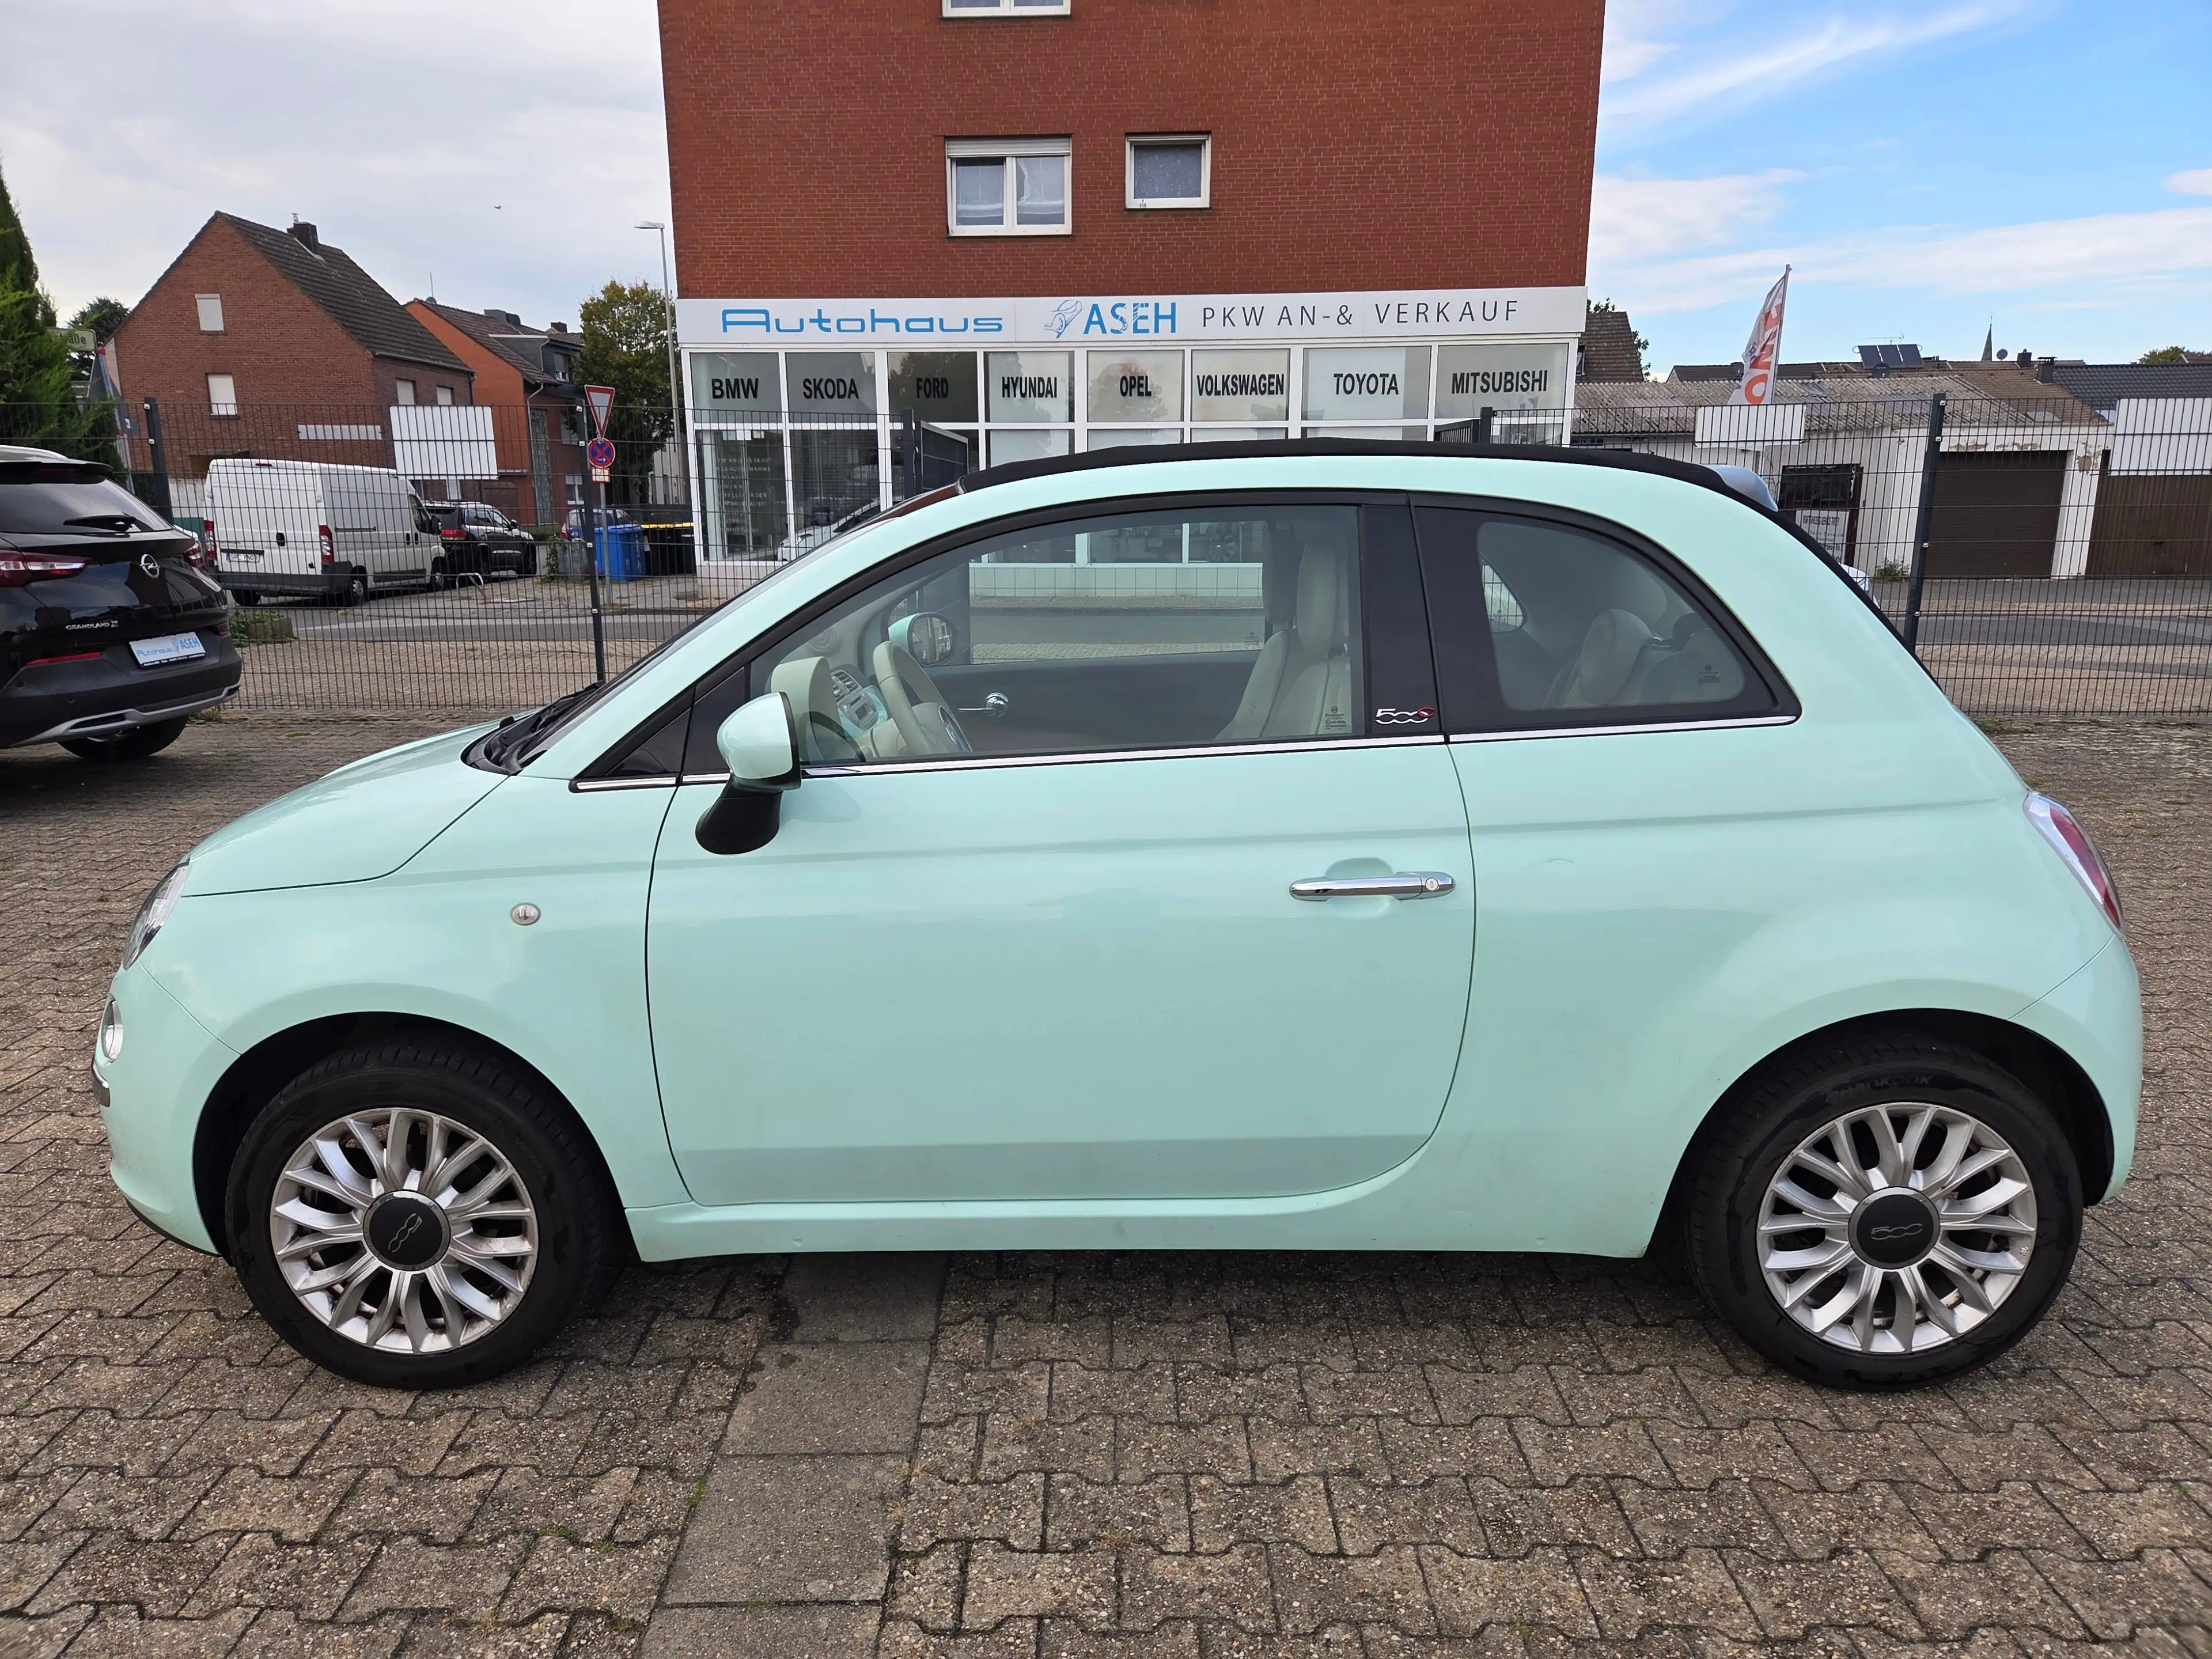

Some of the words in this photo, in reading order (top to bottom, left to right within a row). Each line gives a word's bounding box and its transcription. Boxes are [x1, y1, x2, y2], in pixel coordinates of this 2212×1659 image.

[721, 309, 1003, 333] Autohaus
[1083, 302, 1176, 334] ASEH
[1203, 306, 1264, 327] PKW
[1375, 300, 1517, 324] VERKAUF
[711, 377, 759, 399] BMW
[803, 378, 859, 399] SKODA
[916, 377, 949, 399] FORD
[1002, 376, 1057, 398] HYUNDAI
[1120, 376, 1152, 397] OPEL
[1197, 374, 1284, 396] VOLKSWAGEN
[1334, 373, 1399, 395] TOYOTA
[1452, 370, 1547, 394] MITSUBISHI
[65, 622, 110, 630] GRANDLAND
[179, 637, 200, 650] ASEH
